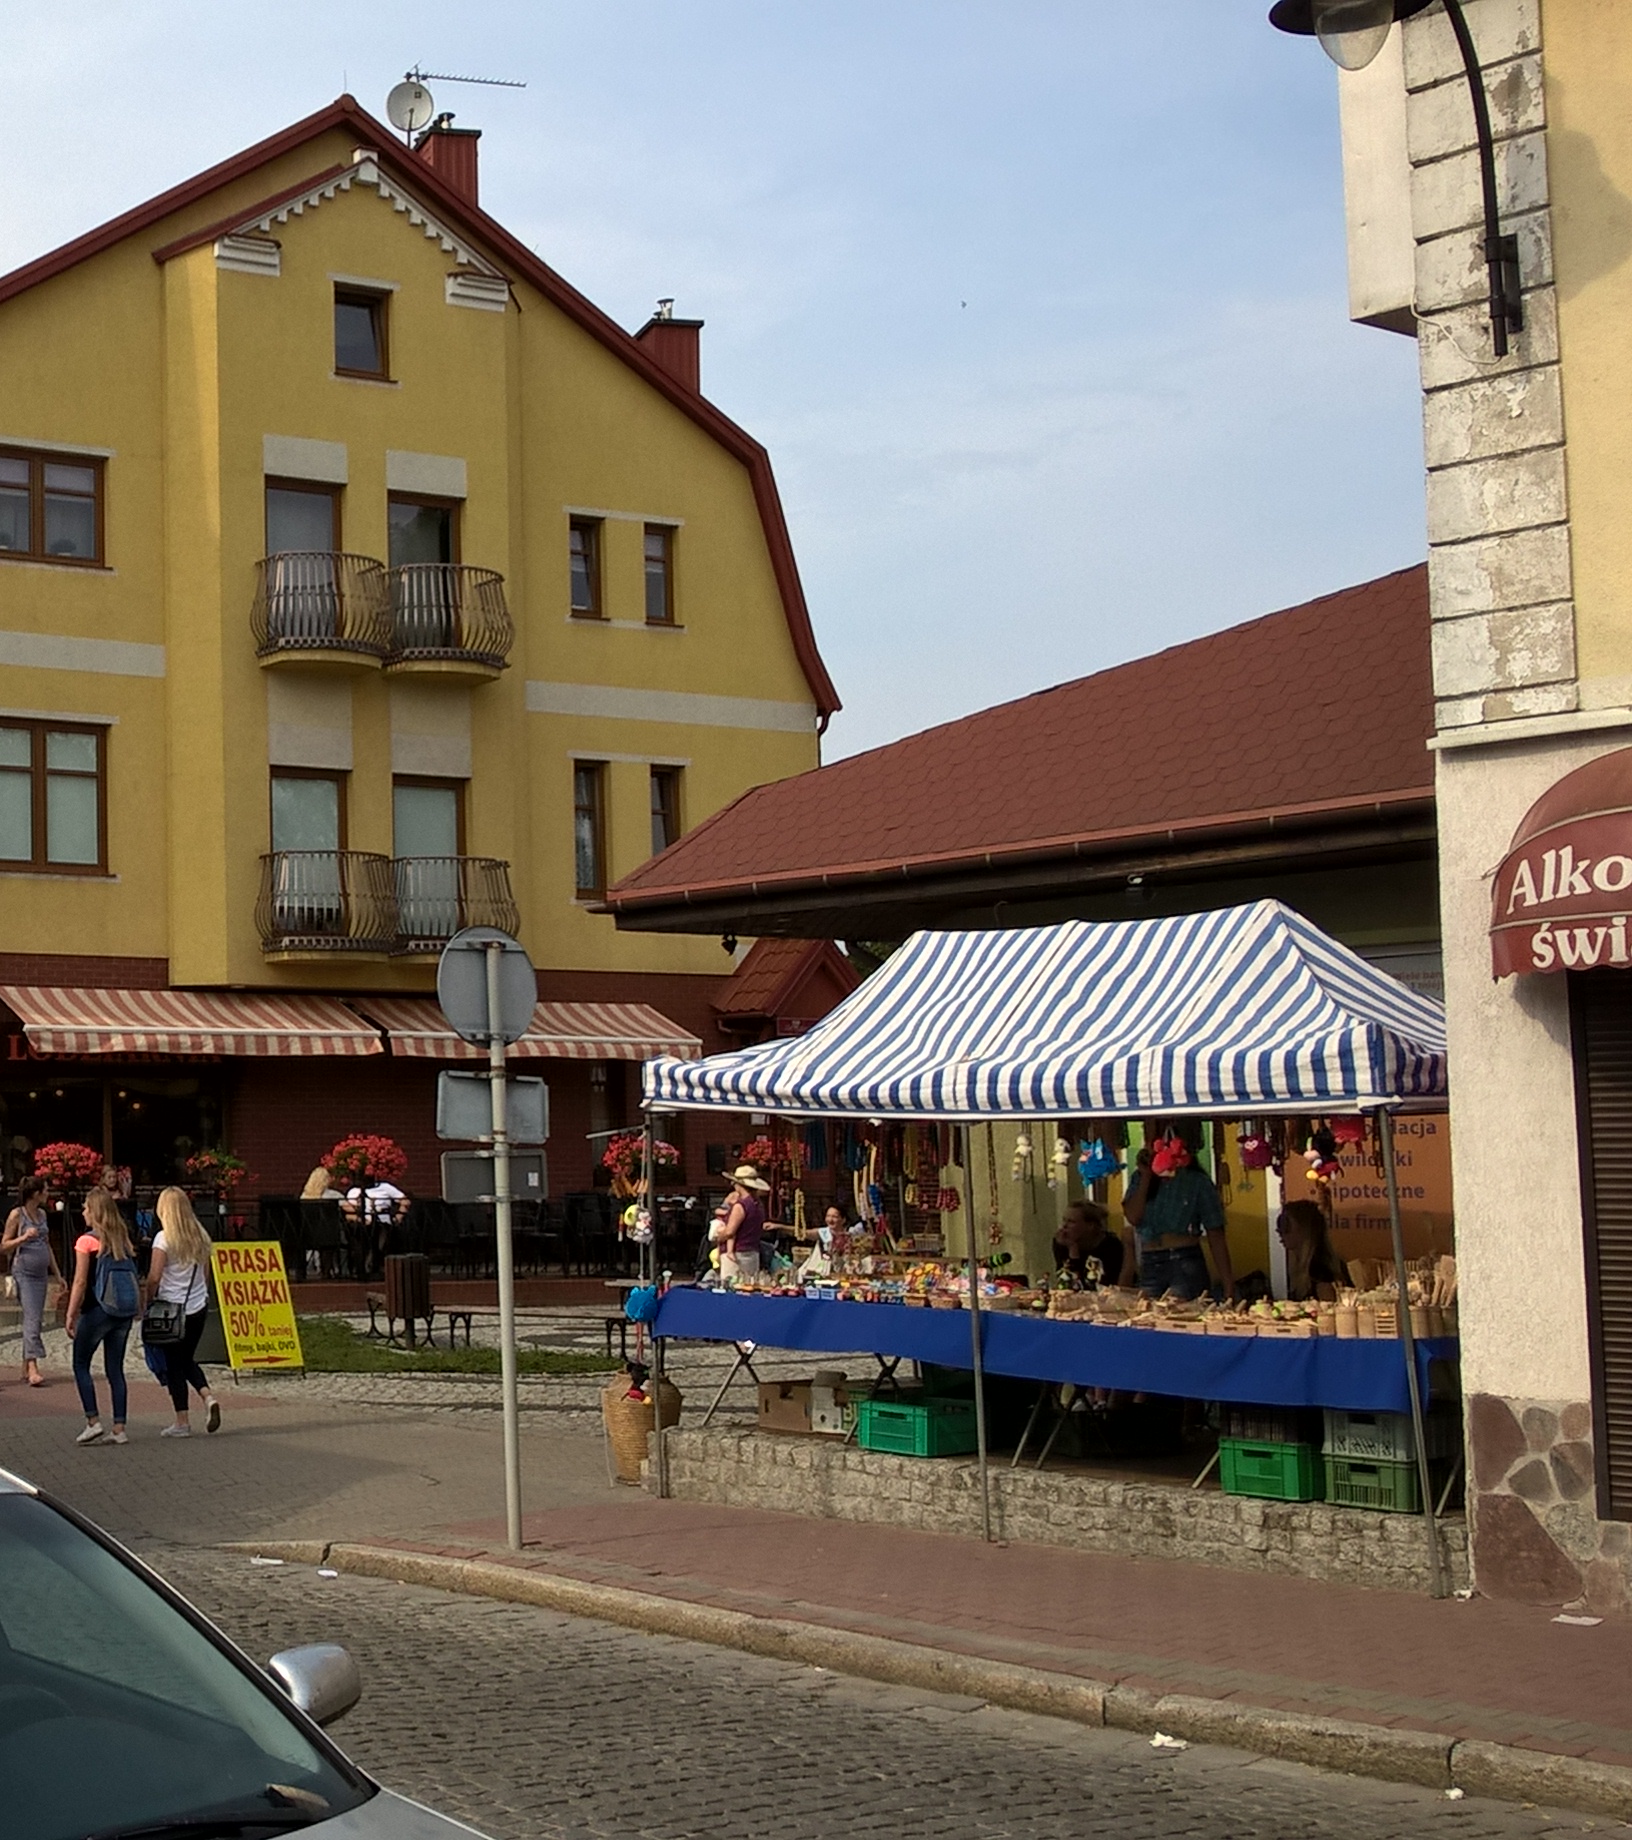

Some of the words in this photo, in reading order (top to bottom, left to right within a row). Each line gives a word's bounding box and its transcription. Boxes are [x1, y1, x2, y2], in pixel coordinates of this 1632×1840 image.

[1506, 844, 1632, 915] Alko
[1531, 915, 1632, 969] świ
[1332, 1185, 1425, 1202] ipotecne
[216, 1248, 282, 1274] PRASA
[221, 1274, 289, 1311] KSIĄŻKI
[230, 1310, 265, 1337] 50%
